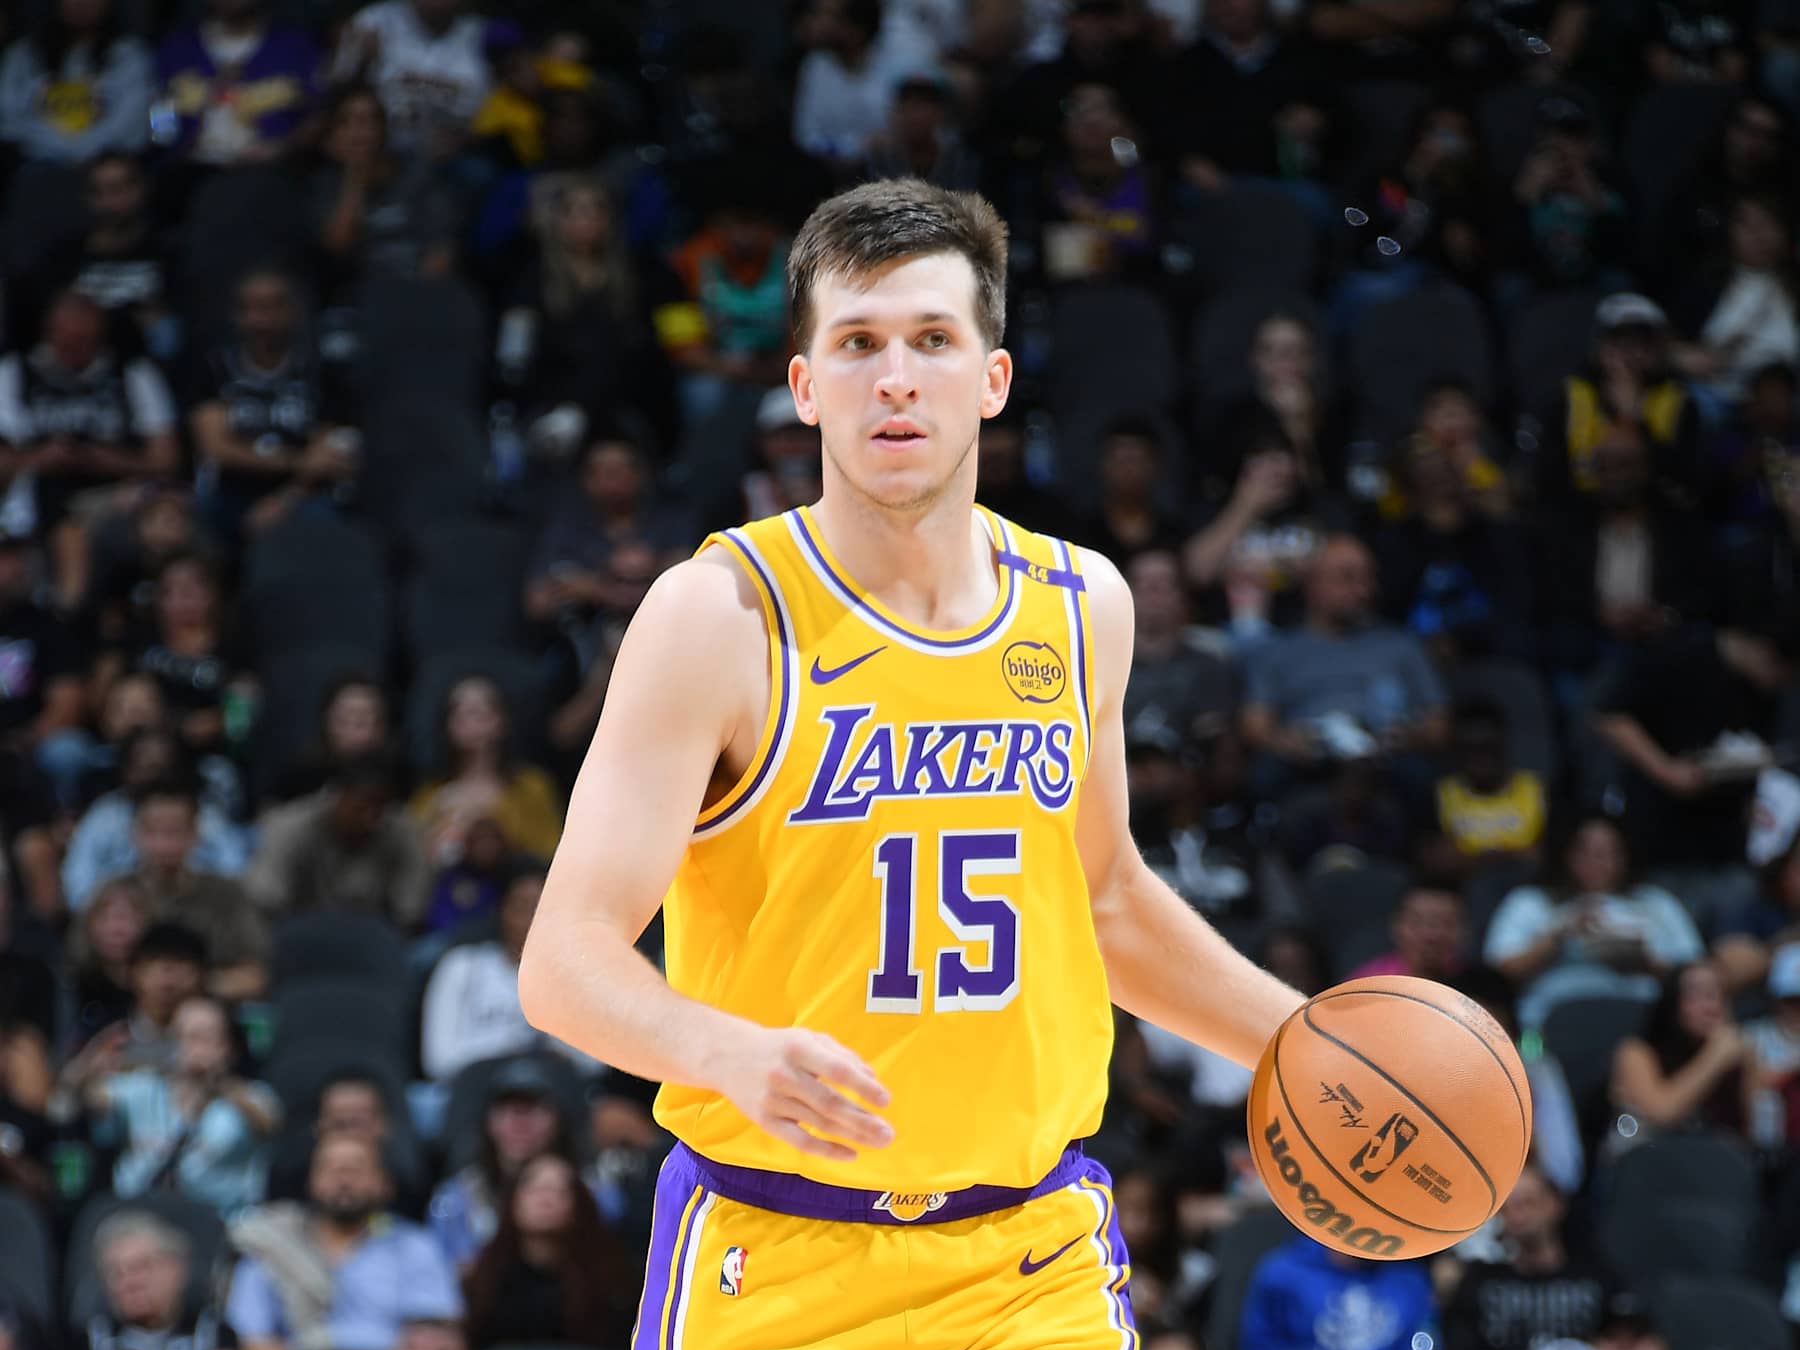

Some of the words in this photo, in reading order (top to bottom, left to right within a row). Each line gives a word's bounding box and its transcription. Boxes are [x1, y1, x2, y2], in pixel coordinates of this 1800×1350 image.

[1027, 563, 1048, 583] 44
[1007, 657, 1062, 686] bibigo
[785, 703, 1075, 825] LAKERS
[866, 829, 1022, 1014] 15
